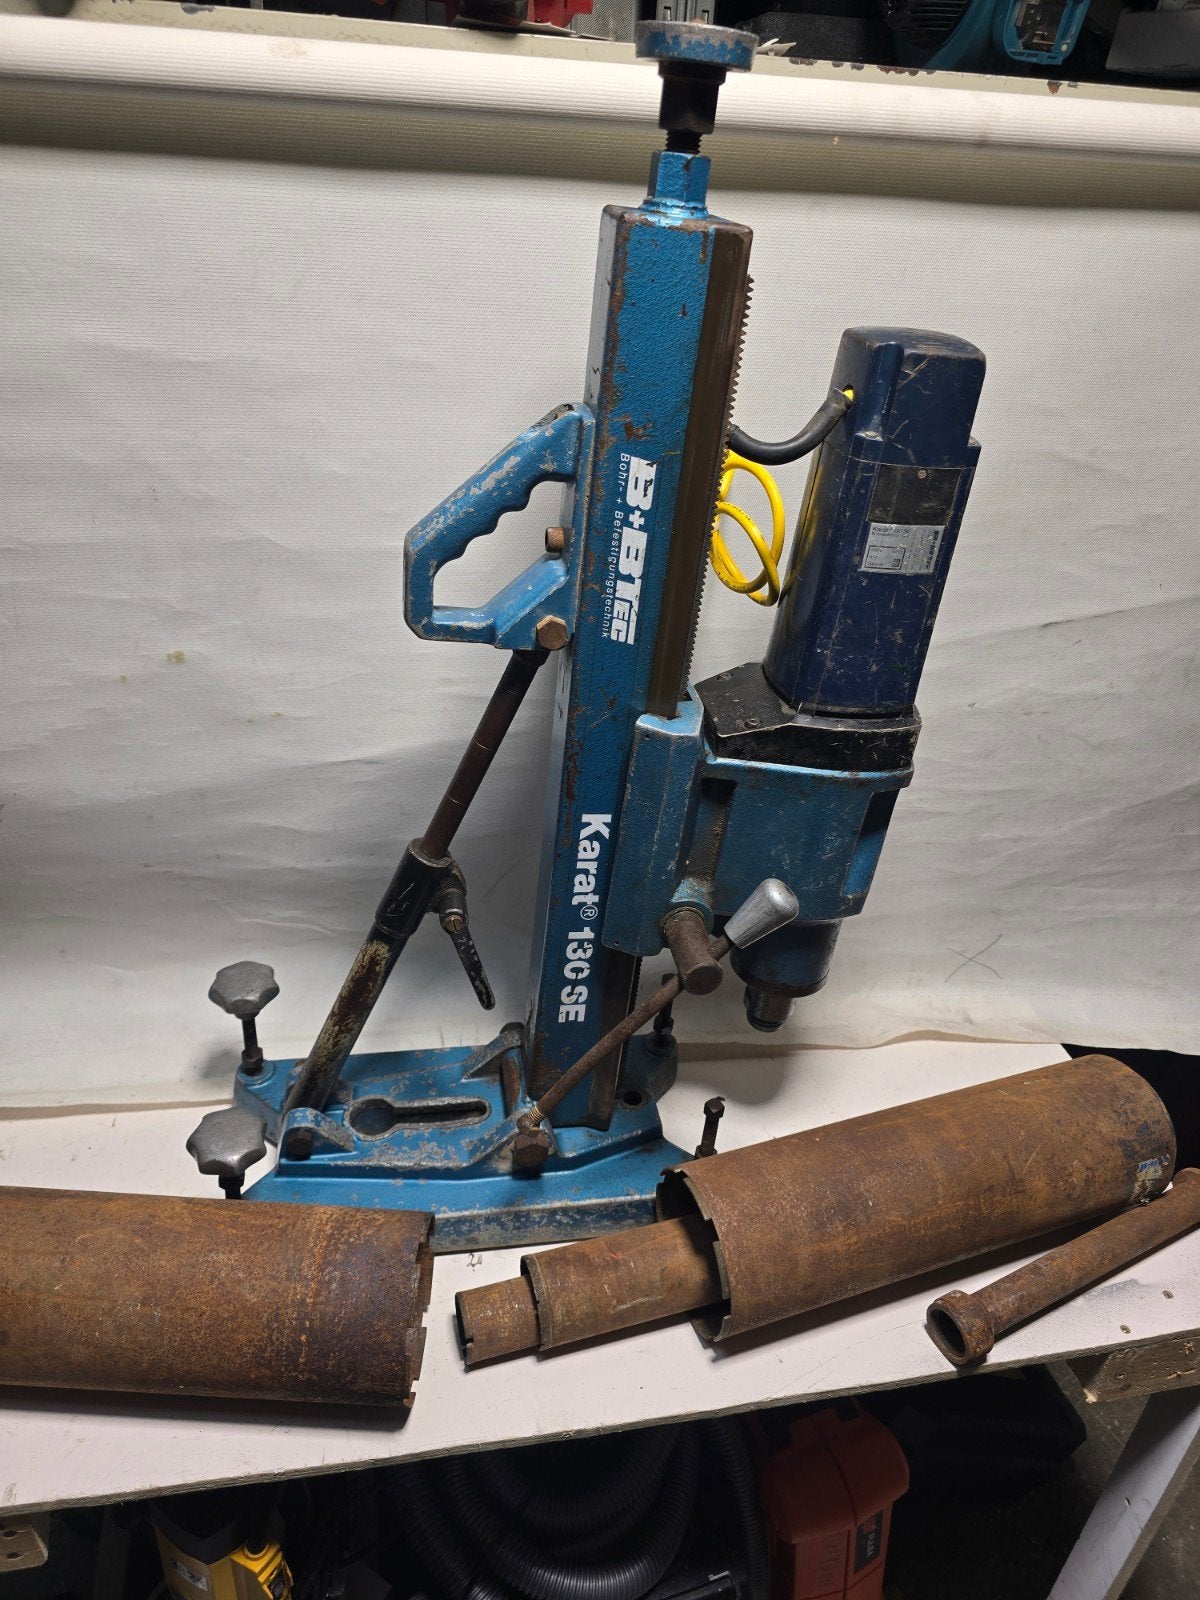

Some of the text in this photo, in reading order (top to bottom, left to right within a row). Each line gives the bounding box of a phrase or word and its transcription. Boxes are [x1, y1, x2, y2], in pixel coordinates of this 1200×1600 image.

[617, 453, 630, 491] Bohr-
[601, 510, 624, 638] Befestigungstechnik
[558, 985, 589, 1023] SE
